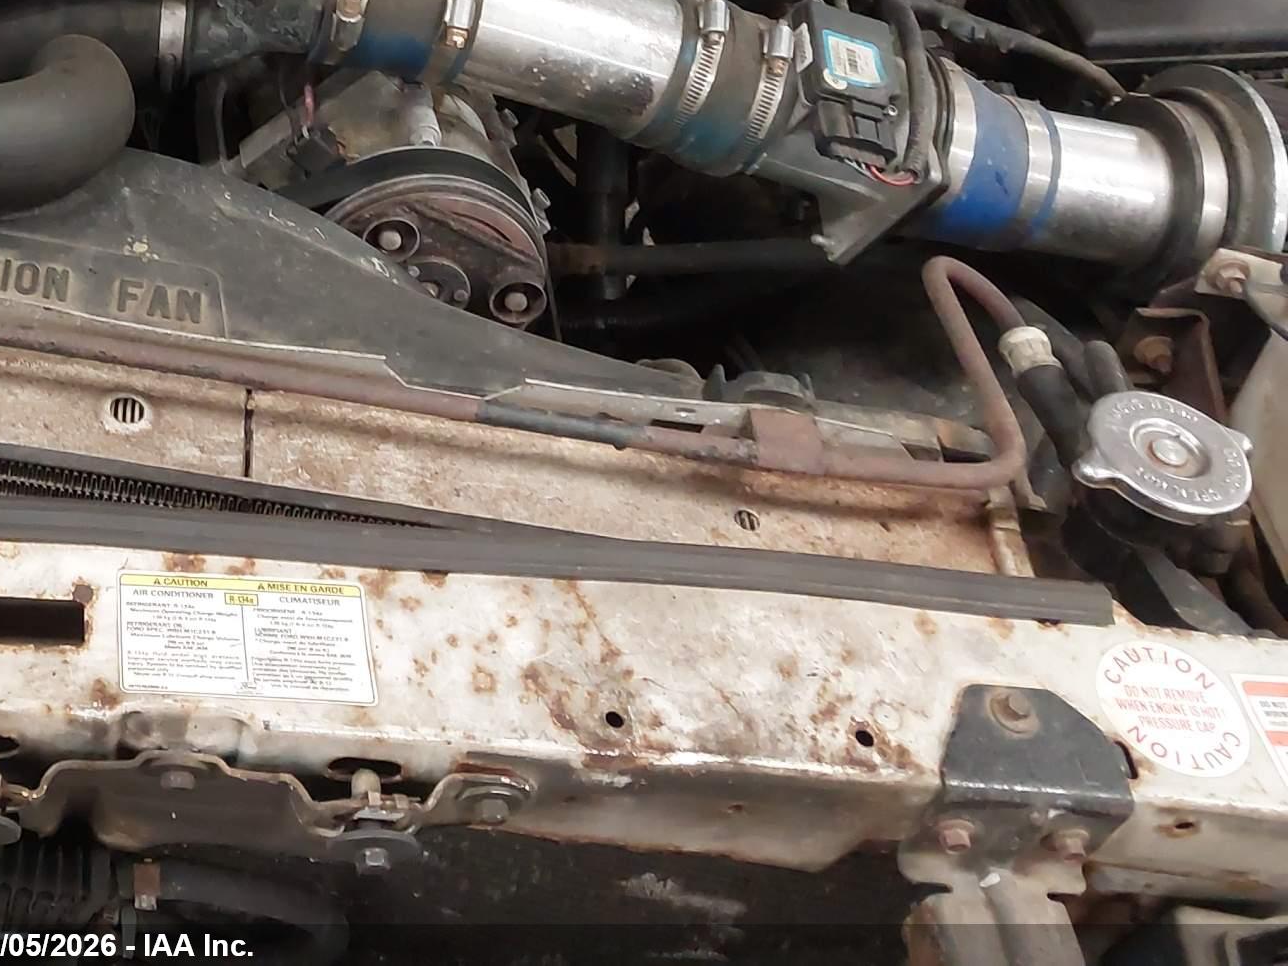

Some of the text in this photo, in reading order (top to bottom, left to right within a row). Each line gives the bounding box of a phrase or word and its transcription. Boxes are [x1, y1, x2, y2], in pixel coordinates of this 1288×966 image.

[116, 277, 202, 324] FAN
[163, 577, 208, 588] CAUTION
[267, 582, 345, 595] MISE EN GARDE
[132, 588, 214, 599] AIR CONDITIONER
[279, 595, 341, 607] CLIMATISEUR
[1103, 646, 1216, 690] CAUTION
[1115, 697, 1148, 712] WHEN
[1149, 700, 1188, 717] ENGINE
[1137, 714, 1217, 734] PRESSURE CAP
[1127, 725, 1242, 772] CAUTION
